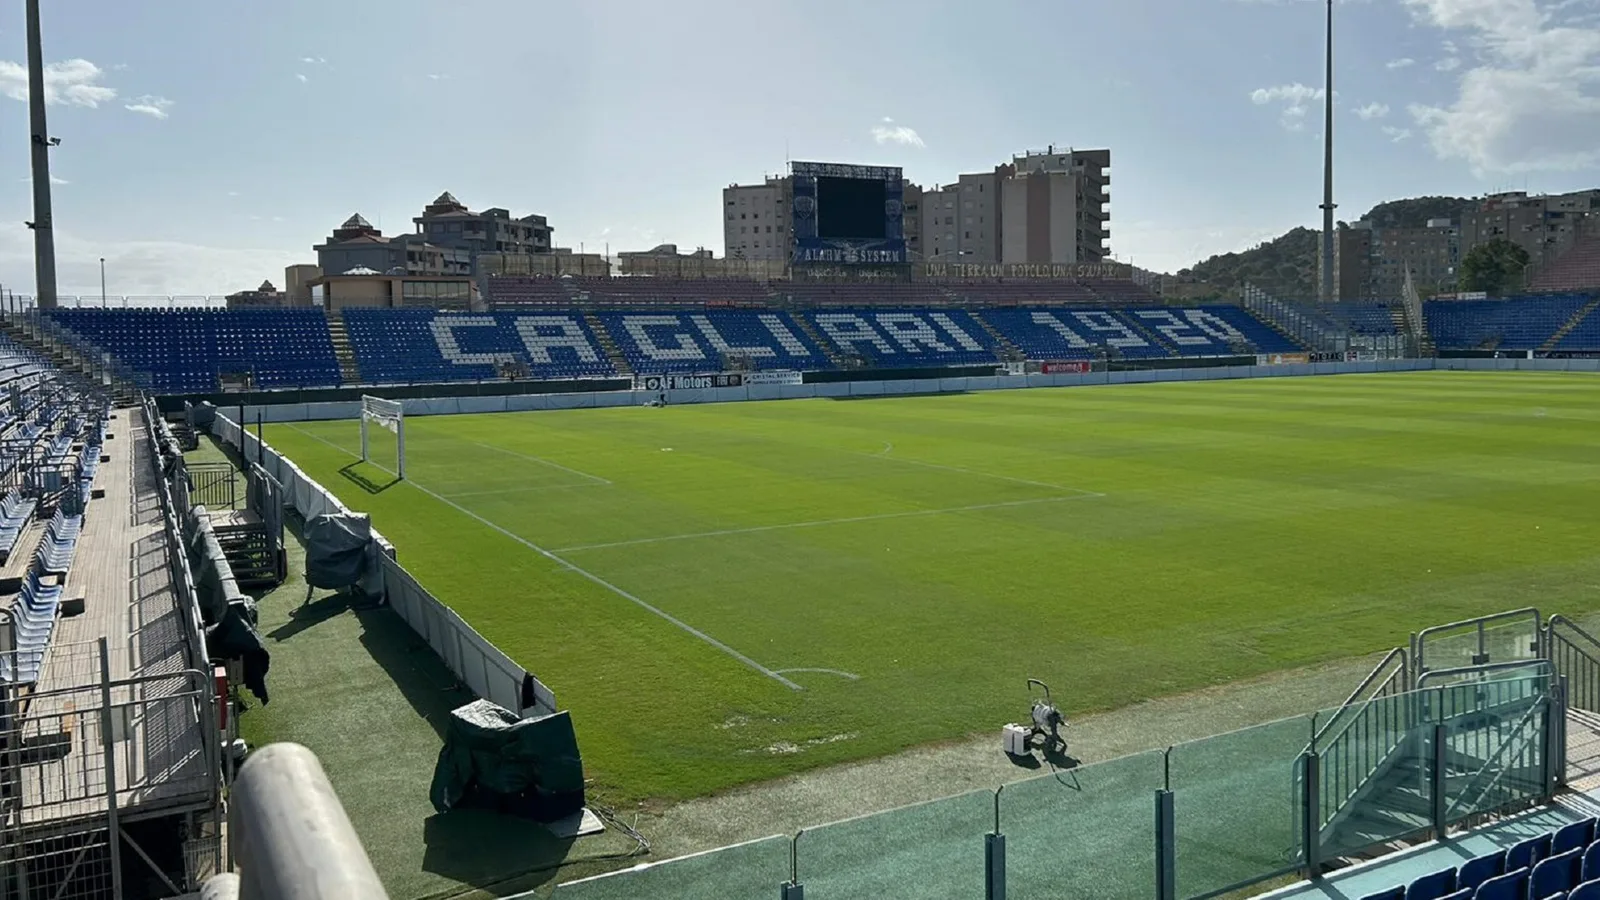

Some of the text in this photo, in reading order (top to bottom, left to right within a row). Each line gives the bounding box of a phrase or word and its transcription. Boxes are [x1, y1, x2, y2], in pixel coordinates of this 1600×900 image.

[805, 249, 900, 262] ALARM SYSTEM
[926, 264, 947, 277] UNA
[1031, 309, 1248, 348] 1920
[428, 312, 985, 364] CAGLIARI
[674, 376, 712, 389] Motors
